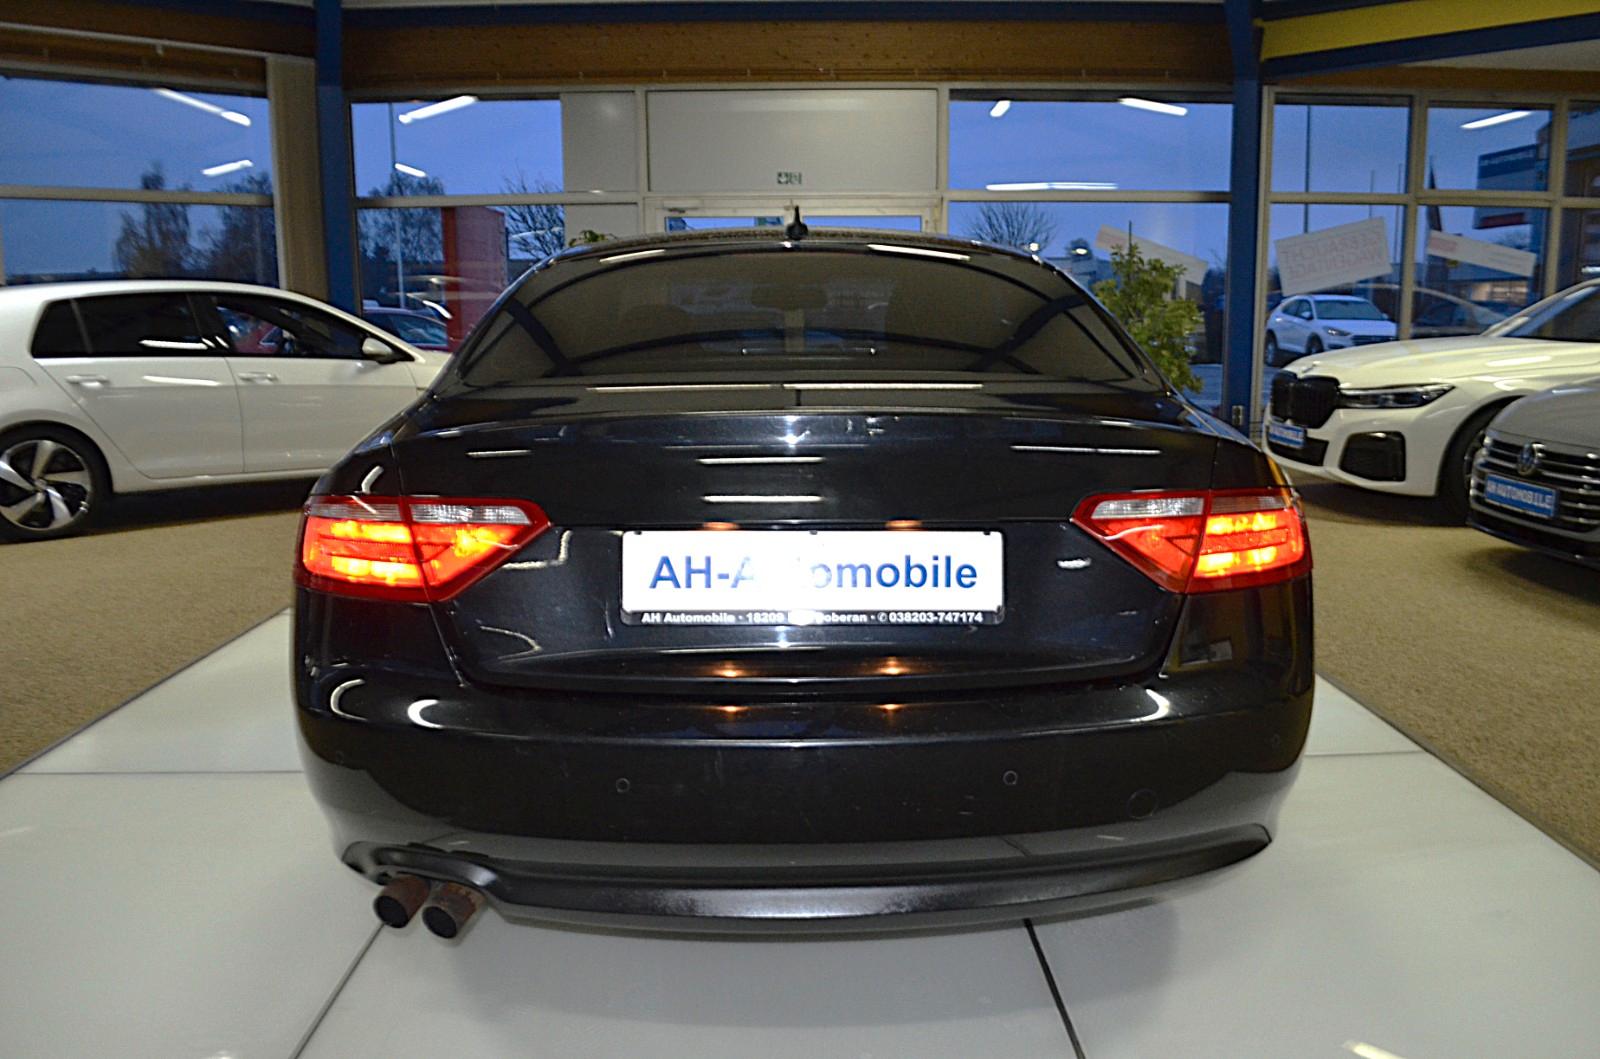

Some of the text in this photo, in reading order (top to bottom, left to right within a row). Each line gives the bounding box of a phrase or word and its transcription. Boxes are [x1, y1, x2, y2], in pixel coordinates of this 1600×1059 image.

[649, 555, 977, 589] AH-Aomobile
[641, 612, 661, 624] AH
[664, 612, 736, 624] Automobile
[748, 612, 785, 624] 18209
[889, 612, 983, 624] 038203-747174
